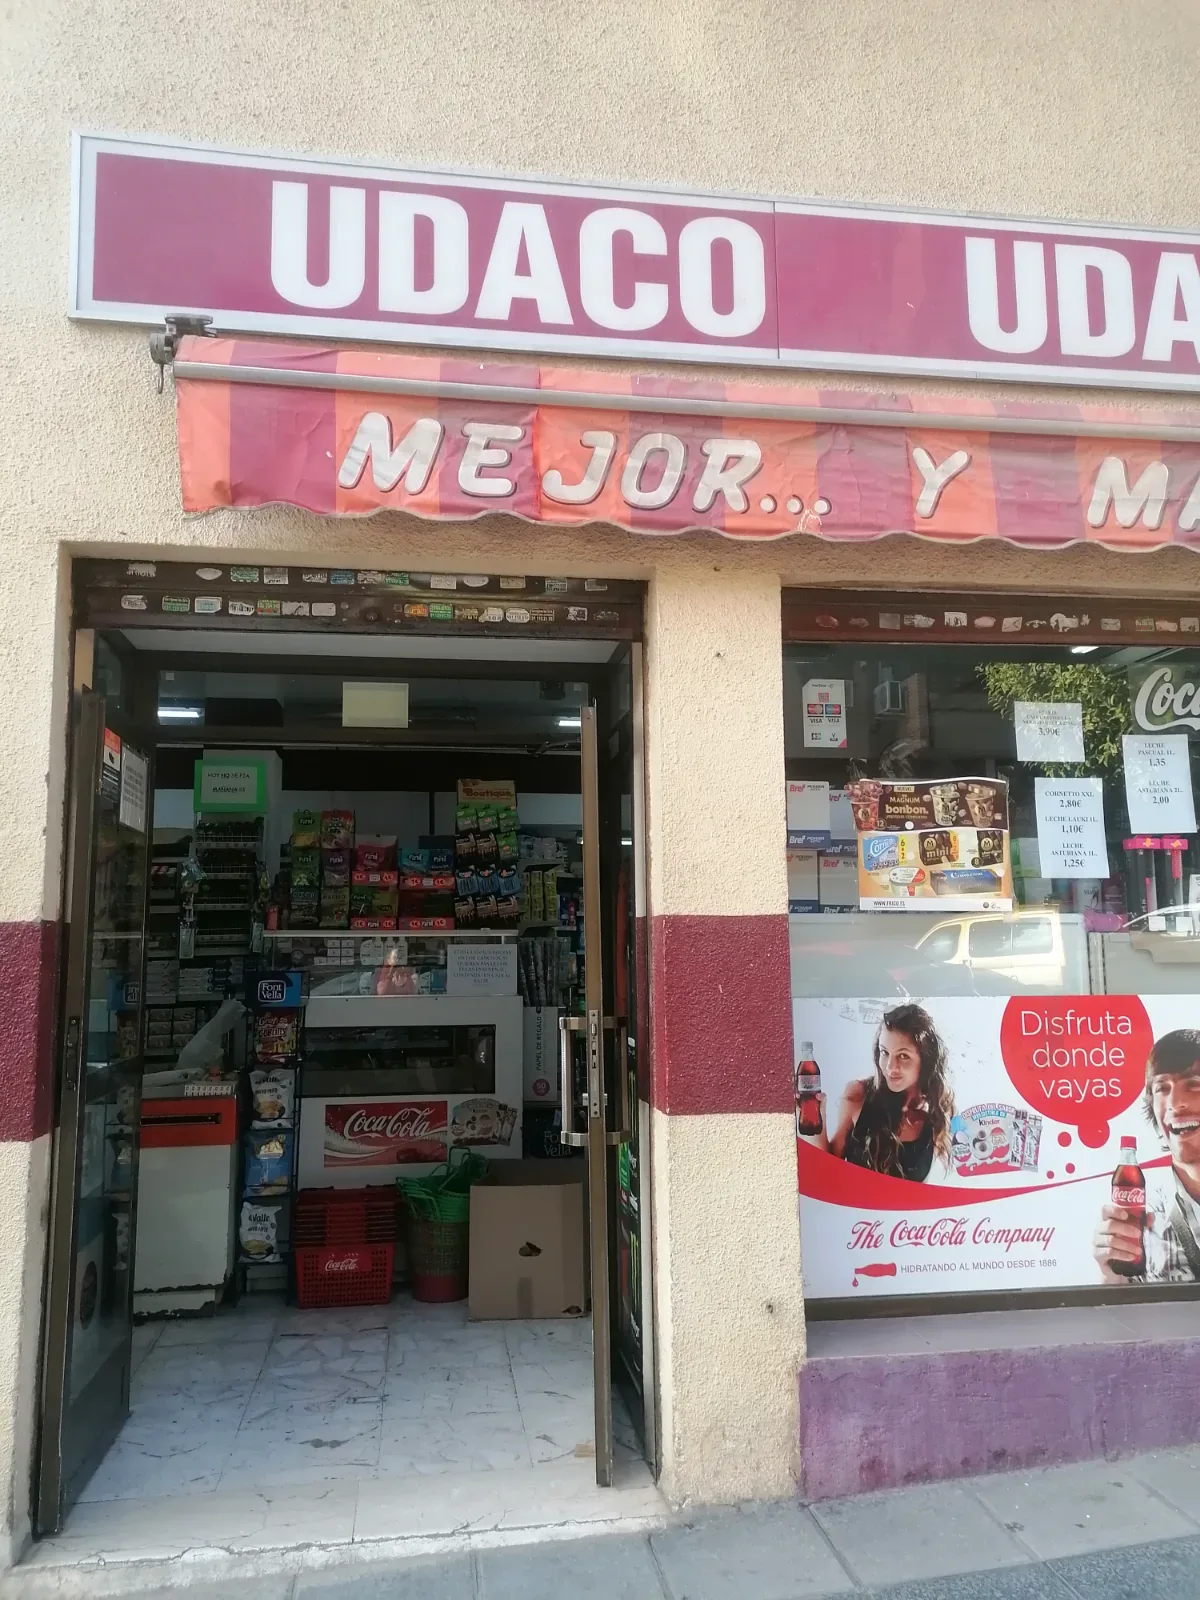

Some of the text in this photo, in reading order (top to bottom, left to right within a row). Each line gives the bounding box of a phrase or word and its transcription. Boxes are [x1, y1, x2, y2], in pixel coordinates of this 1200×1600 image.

[271, 180, 766, 340] UDACO
[965, 236, 1200, 363] UDA
[912, 446, 971, 520] Y
[790, 784, 806, 793] Bref
[889, 796, 921, 804] MAGNUM
[1060, 799, 1082, 808] 2,80€
[1152, 796, 1170, 804] 2,00
[1062, 825, 1084, 834] 1,10€
[789, 835, 806, 844] Bref
[926, 846, 949, 858] mini
[823, 859, 840, 868] Bref
[1064, 859, 1086, 868] 1,25€
[261, 982, 282, 991] Font
[261, 990, 283, 999] Vella
[1021, 1009, 1133, 1036] Disfruta
[1032, 1041, 1125, 1068] donde
[1038, 1076, 1122, 1104] vayas
[343, 1107, 435, 1139] Coca-Cola
[1112, 1187, 1145, 1203] Coca-Cola
[846, 1216, 1056, 1253] The Coca-Cola Company
[325, 1259, 358, 1271] Coca-Cola
[900, 1257, 1058, 1274] HIDRATANDO AL MUNDO DESDE 1886
